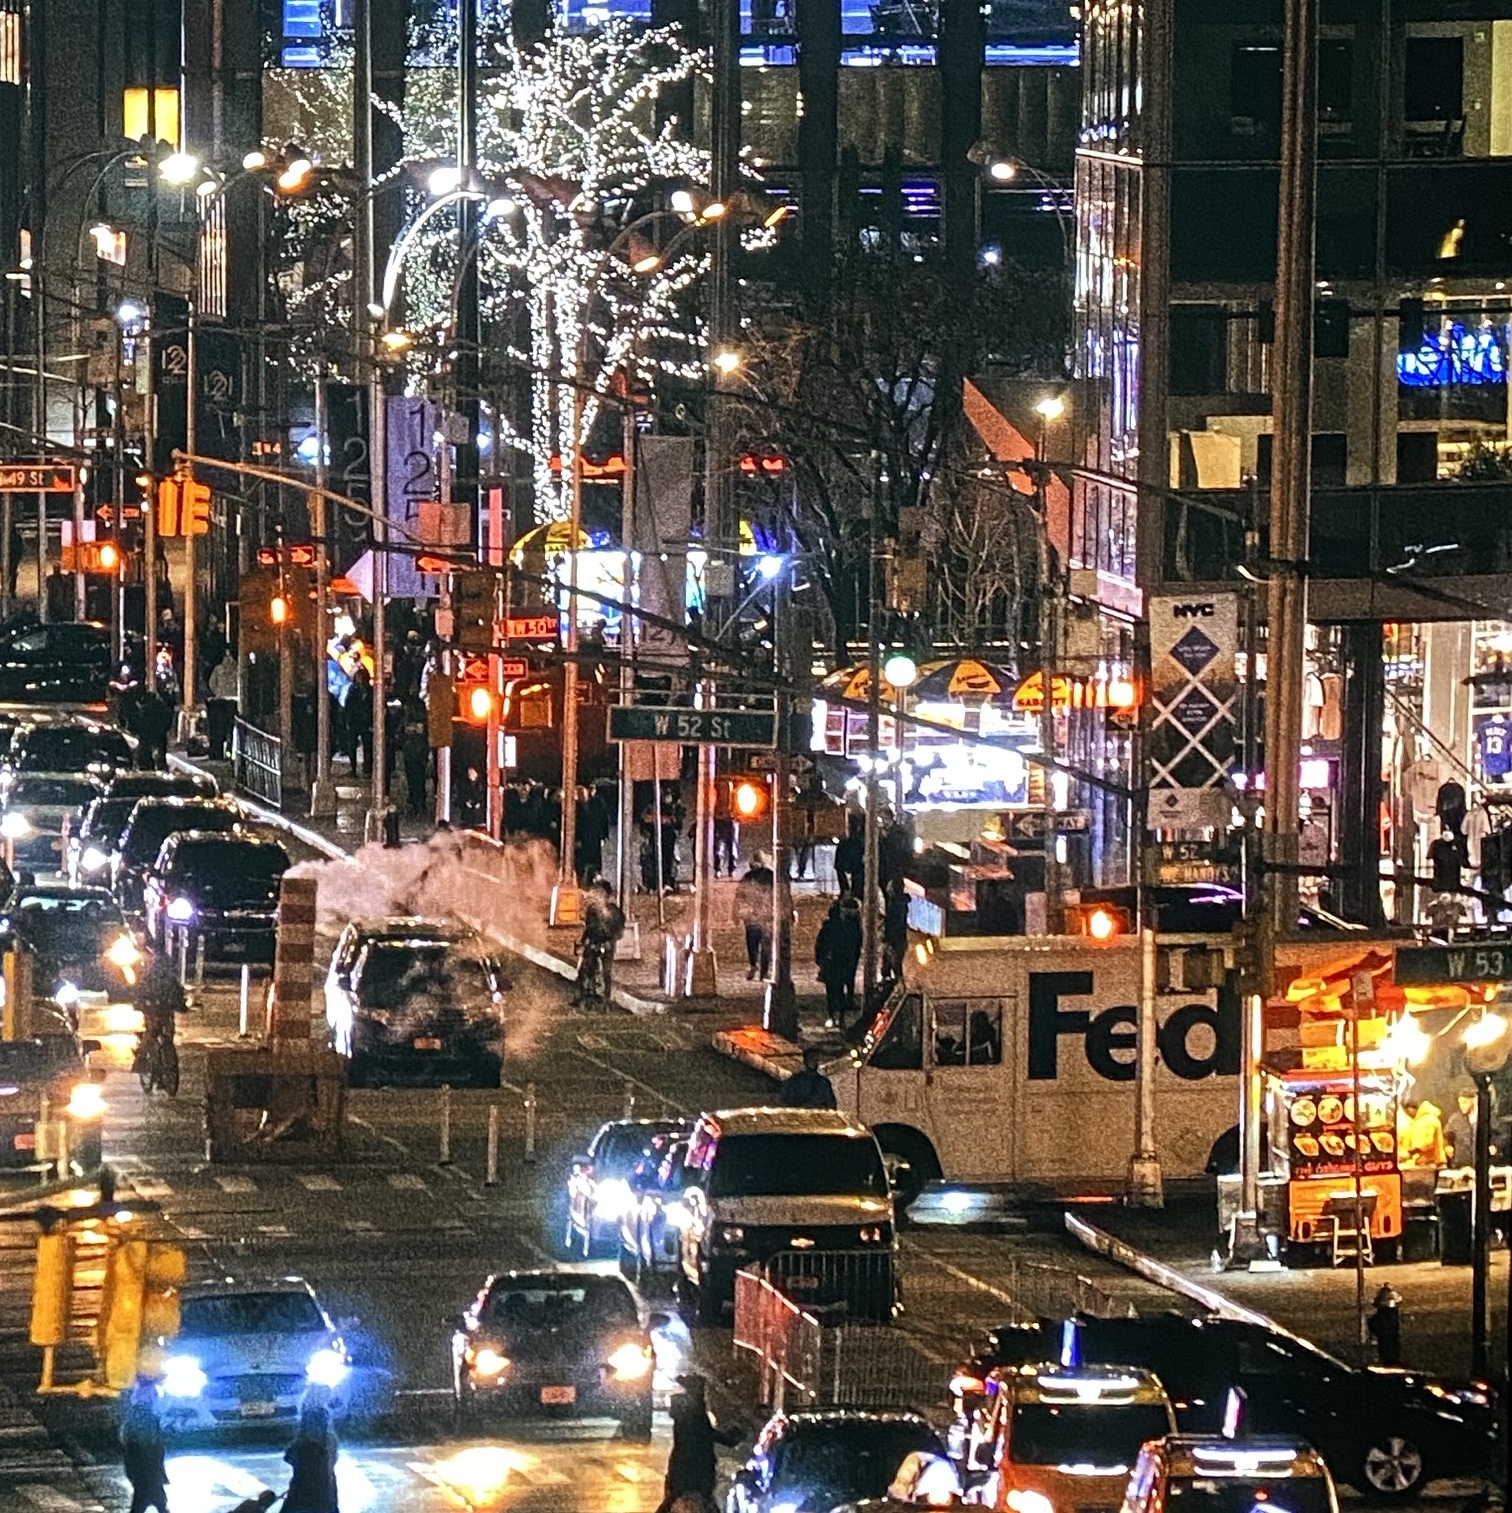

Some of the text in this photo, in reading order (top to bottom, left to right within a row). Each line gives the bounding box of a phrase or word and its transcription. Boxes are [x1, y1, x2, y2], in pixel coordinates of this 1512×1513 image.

[9, 471, 26, 486] 49
[29, 470, 44, 486] St
[1173, 603, 1214, 618] NYC
[654, 715, 732, 739] W 52 St
[1486, 737, 1503, 755] 13
[1179, 843, 1199, 860] 52
[1447, 951, 1504, 978] W 53
[1028, 969, 1242, 1081] Fed
